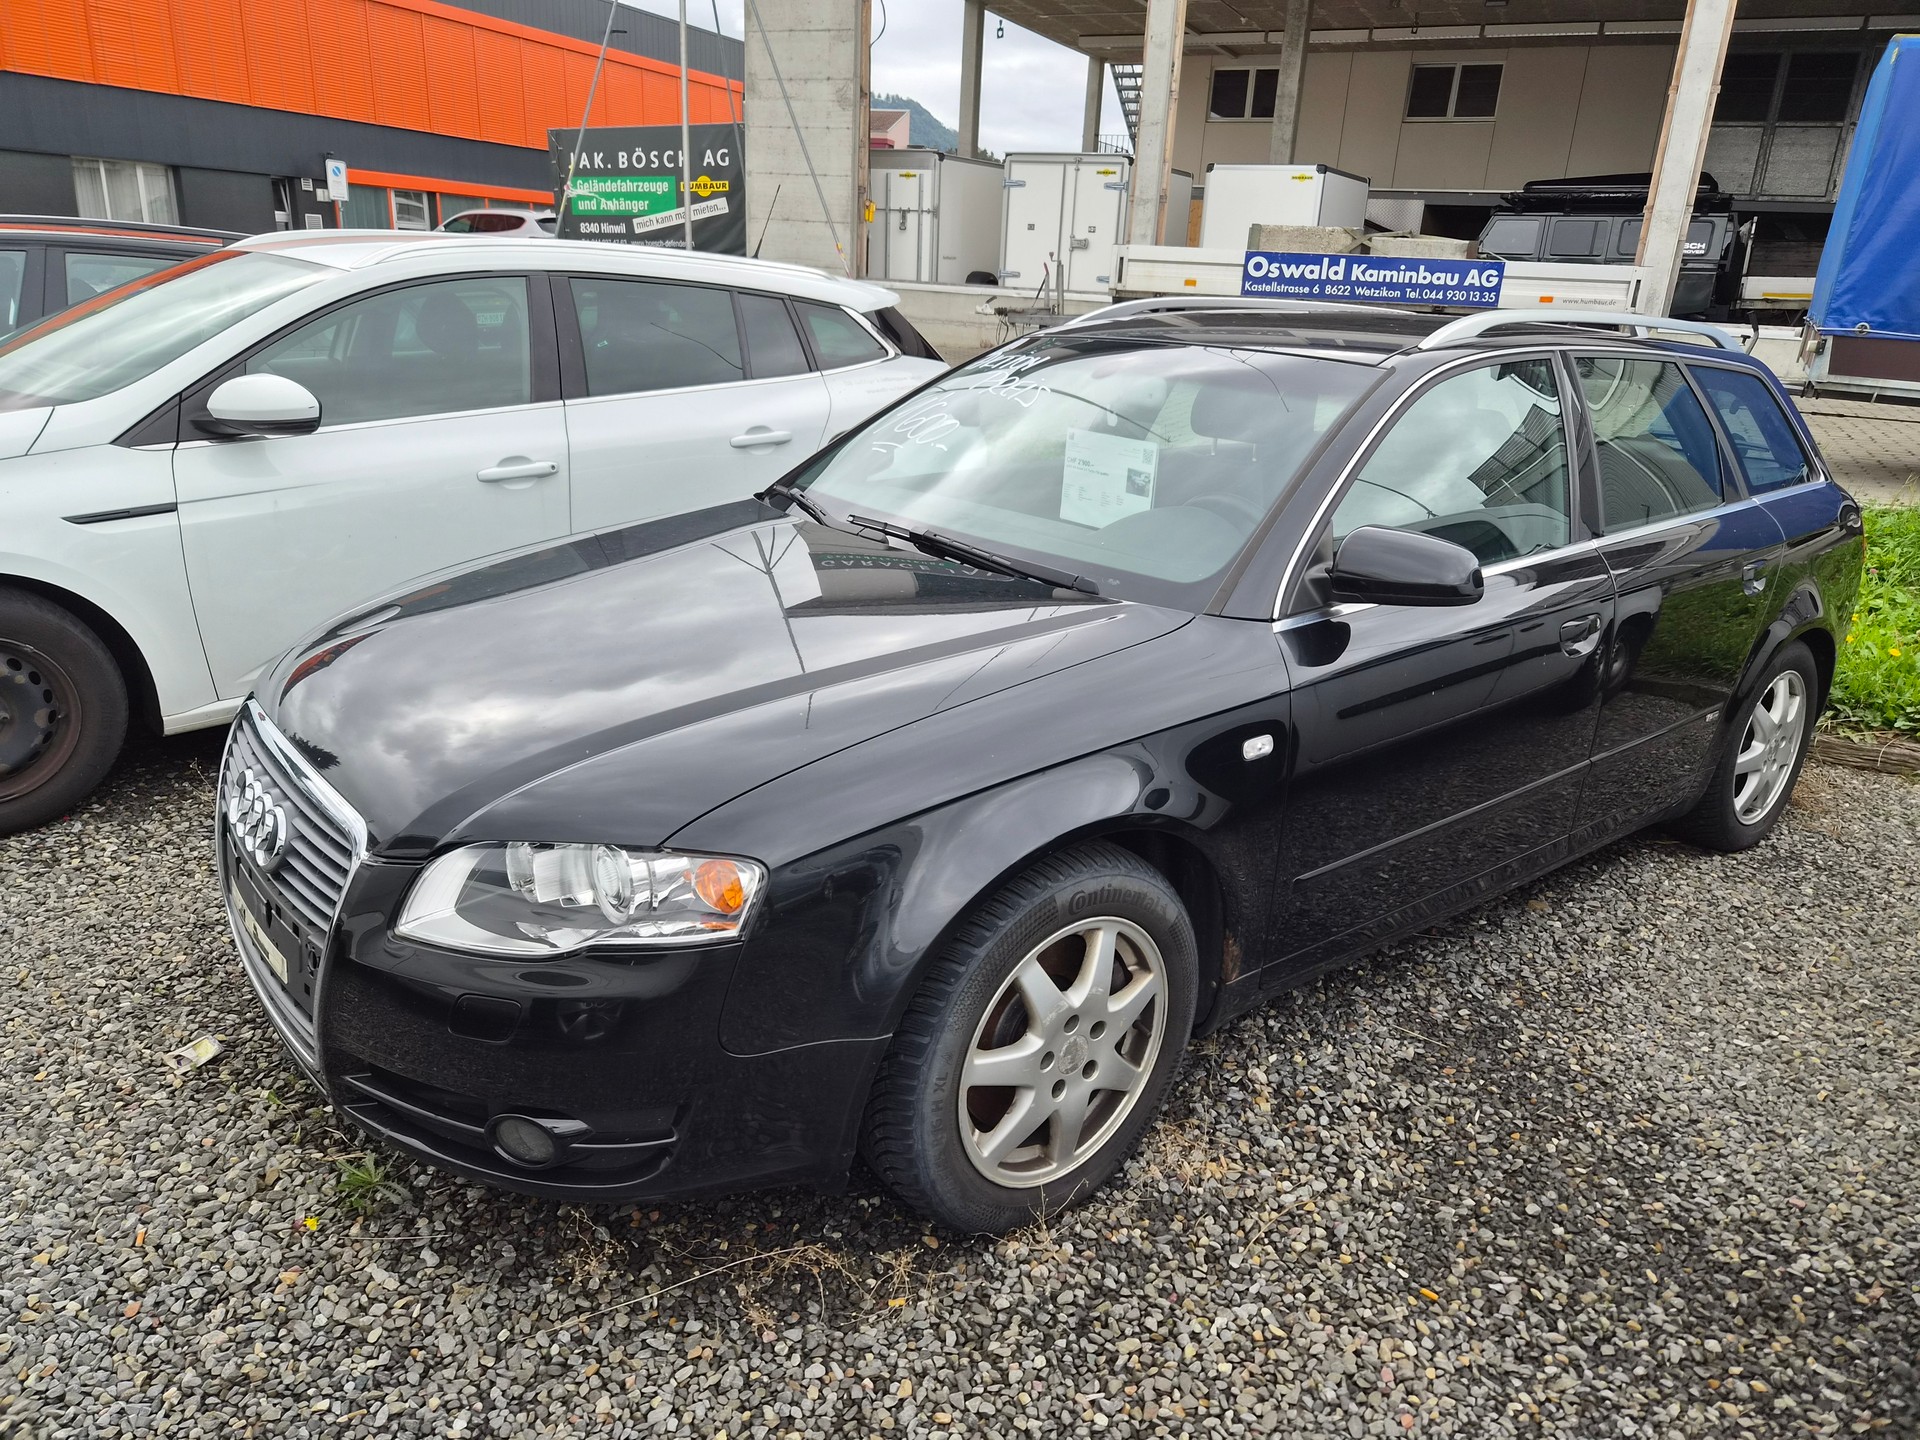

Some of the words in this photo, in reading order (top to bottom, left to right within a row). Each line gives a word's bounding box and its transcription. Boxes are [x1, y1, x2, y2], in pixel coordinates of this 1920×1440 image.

[703, 148, 729, 167] AG
[577, 179, 669, 195] Geländefahrzeuge
[682, 181, 728, 190] UMBAUR
[578, 198, 597, 210] und
[600, 198, 649, 212] Anhänger
[580, 222, 600, 234] 8340
[600, 222, 626, 234] Hinwil
[636, 217, 655, 230] mich
[655, 214, 674, 225] kann
[675, 211, 687, 220] ma
[1247, 256, 1346, 280] Oswald
[1351, 263, 1459, 285] Kaminbau
[1463, 269, 1499, 287] AG
[1244, 281, 1310, 294] Kastellstrasse
[1313, 284, 1320, 294] 6
[1325, 285, 1350, 295] 8622
[1354, 286, 1401, 298] Wetzikon
[1446, 290, 1467, 301] 930
[1562, 298, 1617, 306] www.humbaur.de
[1068, 883, 1161, 915] Continental
